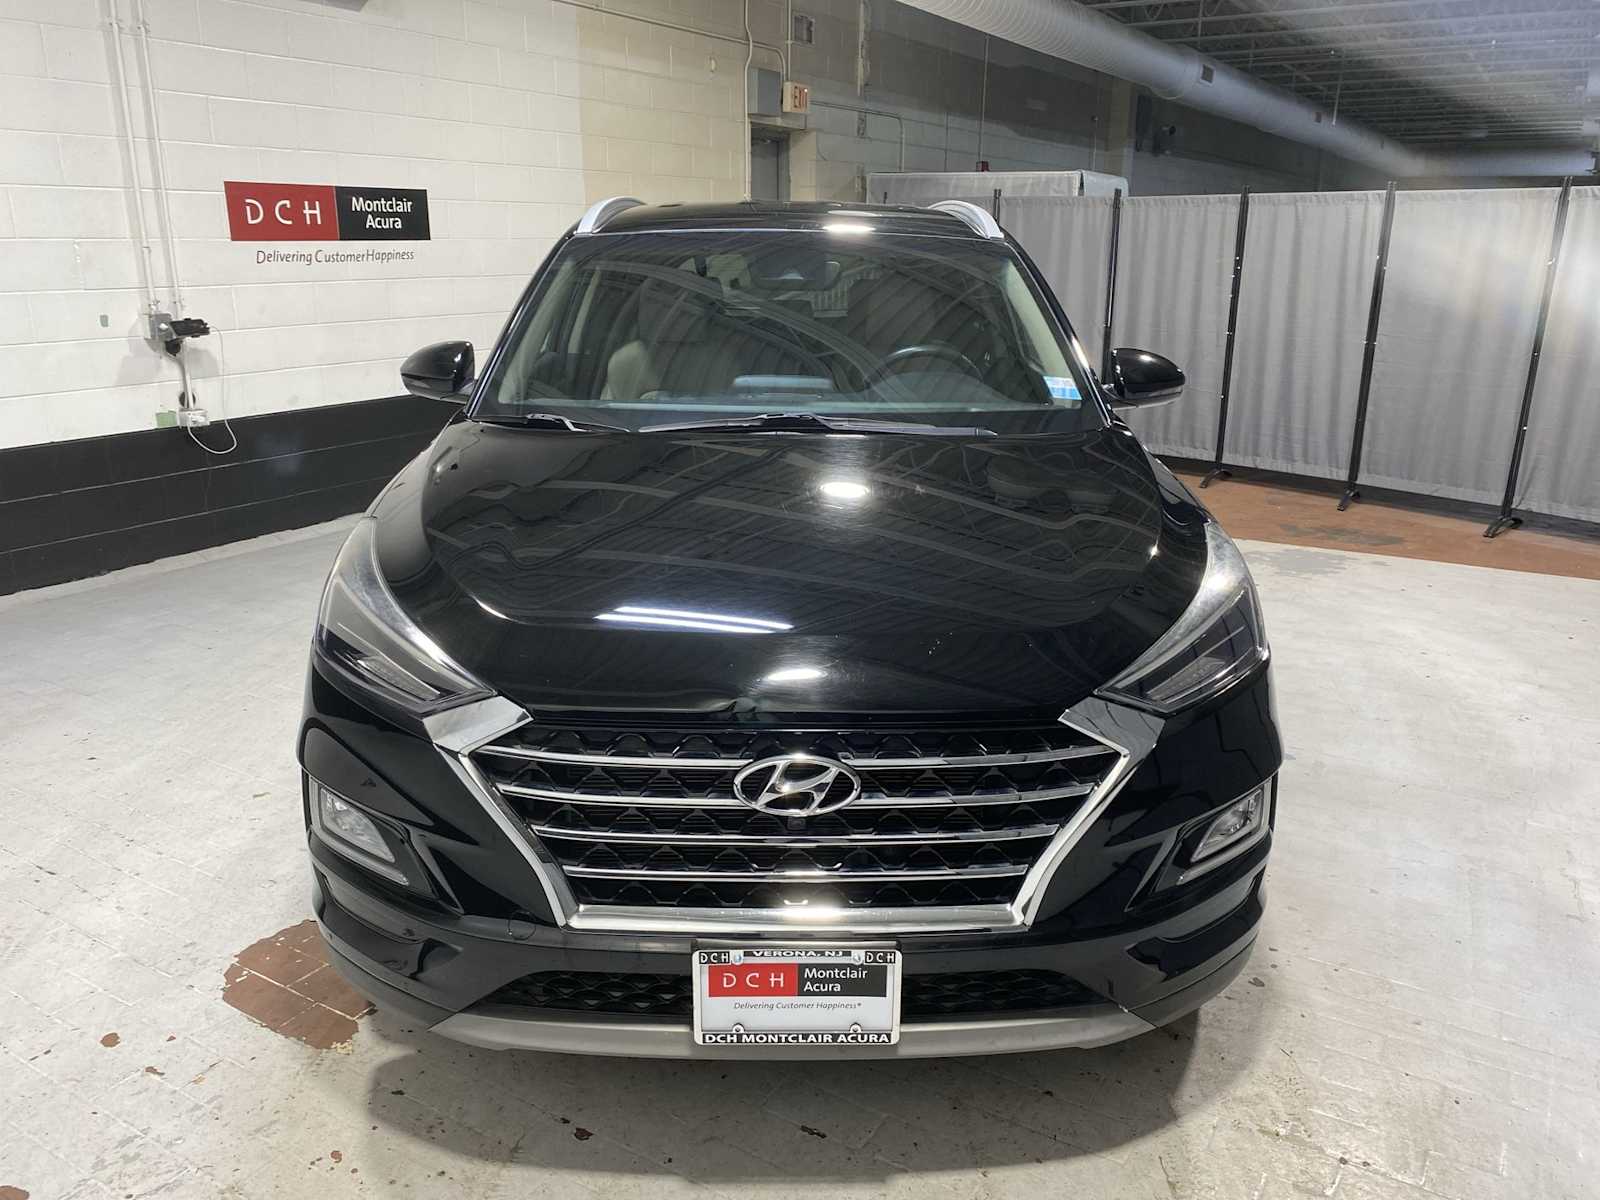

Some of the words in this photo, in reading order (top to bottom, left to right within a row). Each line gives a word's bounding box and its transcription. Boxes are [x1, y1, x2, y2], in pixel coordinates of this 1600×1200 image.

[352, 196, 413, 213] Montclair
[366, 214, 402, 229] Acura
[256, 250, 313, 266] Delivering
[314, 249, 366, 263] Customer
[366, 248, 415, 263] Happiness
[700, 952, 730, 964] DCH
[865, 952, 896, 964] DCH
[804, 967, 868, 979] Montclair
[803, 981, 842, 992] Acura
[733, 1002, 774, 1010] Delivering
[705, 1034, 738, 1043] DCH
[742, 1034, 832, 1043] MONTCLAIR
[836, 1034, 889, 1043] ACURA
